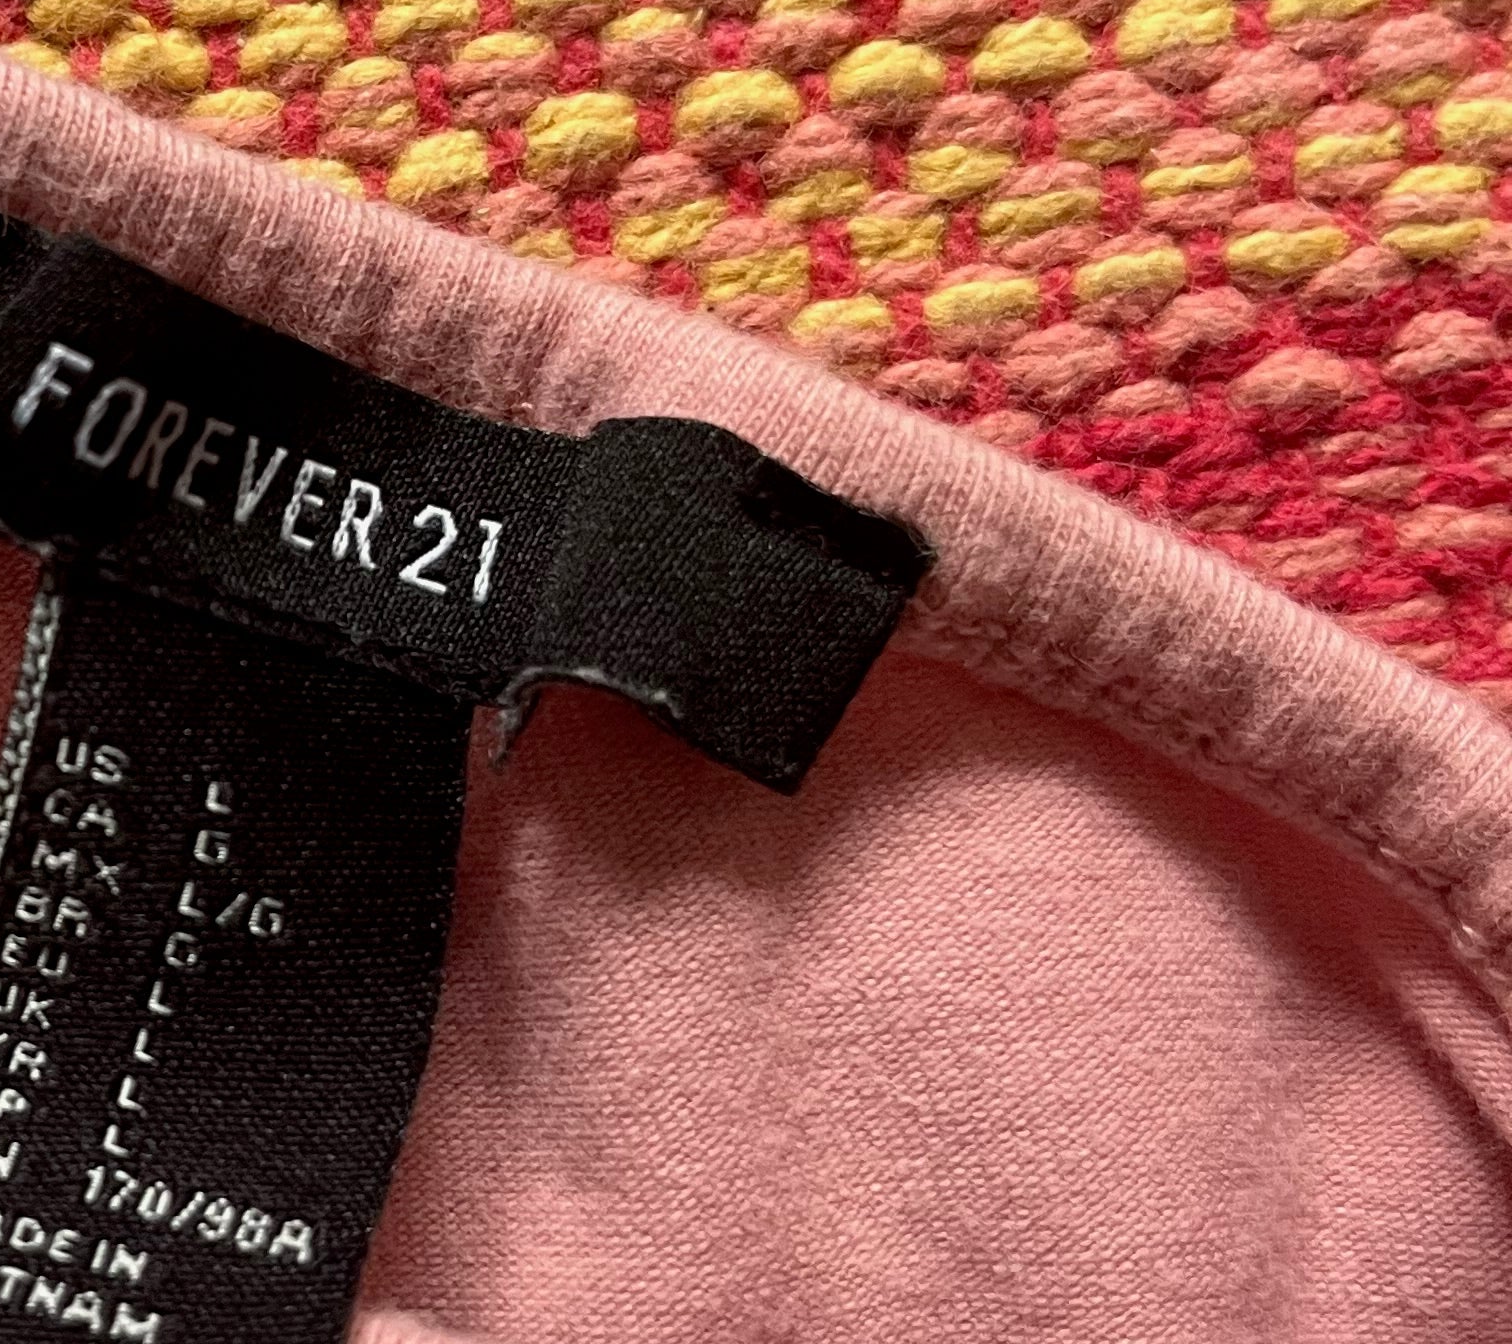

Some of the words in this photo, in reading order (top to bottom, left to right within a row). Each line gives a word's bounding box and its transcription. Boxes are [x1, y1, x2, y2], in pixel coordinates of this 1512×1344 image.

[12, 342, 384, 571] FOREVER
[399, 505, 503, 605] 21
[56, 738, 129, 783] US
[205, 781, 232, 814] L
[43, 788, 118, 837] CA
[194, 830, 231, 865] G
[15, 886, 89, 938] BR
[164, 931, 199, 968] G
[32, 840, 126, 895] MX
[178, 882, 285, 937] L/G
[1, 934, 68, 977] EU
[148, 981, 173, 1016] L
[133, 1028, 158, 1064] L
[117, 1075, 146, 1116] L
[103, 1124, 129, 1157] L
[84, 1166, 313, 1264] 170/98A
[91, 1239, 148, 1282] IN
